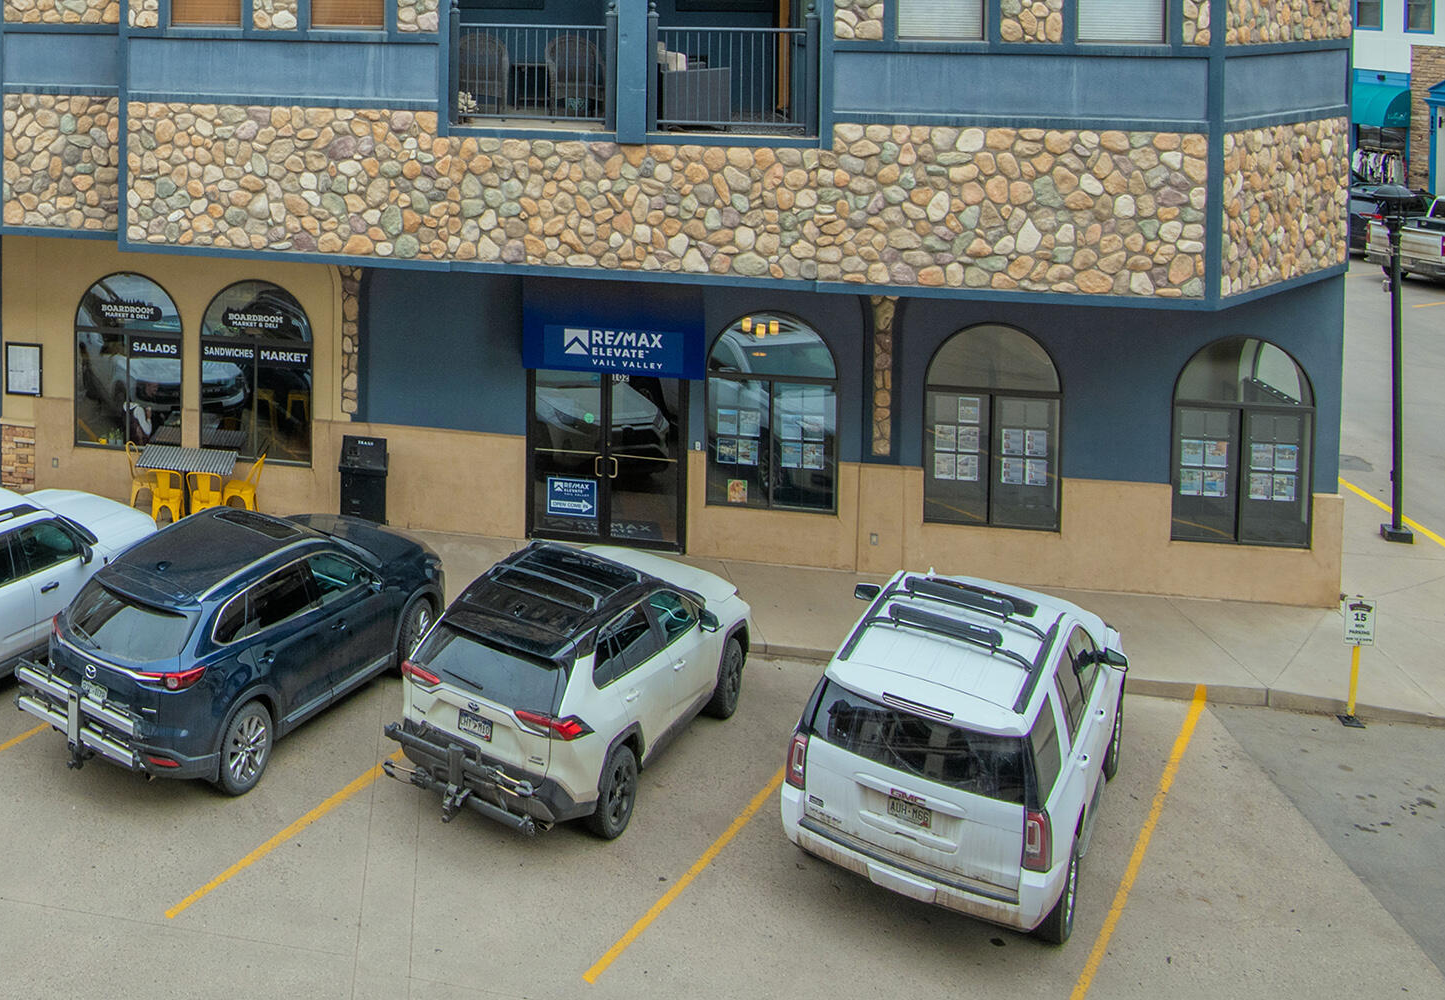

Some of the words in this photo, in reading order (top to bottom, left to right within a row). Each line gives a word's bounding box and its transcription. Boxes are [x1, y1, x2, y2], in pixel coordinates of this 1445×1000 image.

[101, 304, 154, 315] BOARDROOM
[105, 311, 129, 319] MARKET
[228, 313, 283, 324] BOARDROOM
[232, 320, 257, 328] MARKET
[592, 330, 663, 349] RE/MAX
[133, 342, 177, 354] SALADS
[204, 346, 254, 358] SANDWICHES
[260, 350, 308, 363] MARKET
[592, 359, 616, 367] VAIL
[622, 361, 663, 369] VALLEY
[564, 482, 590, 490] RE/MAX
[1354, 612, 1367, 622] 15
[890, 787, 926, 806] GMC
